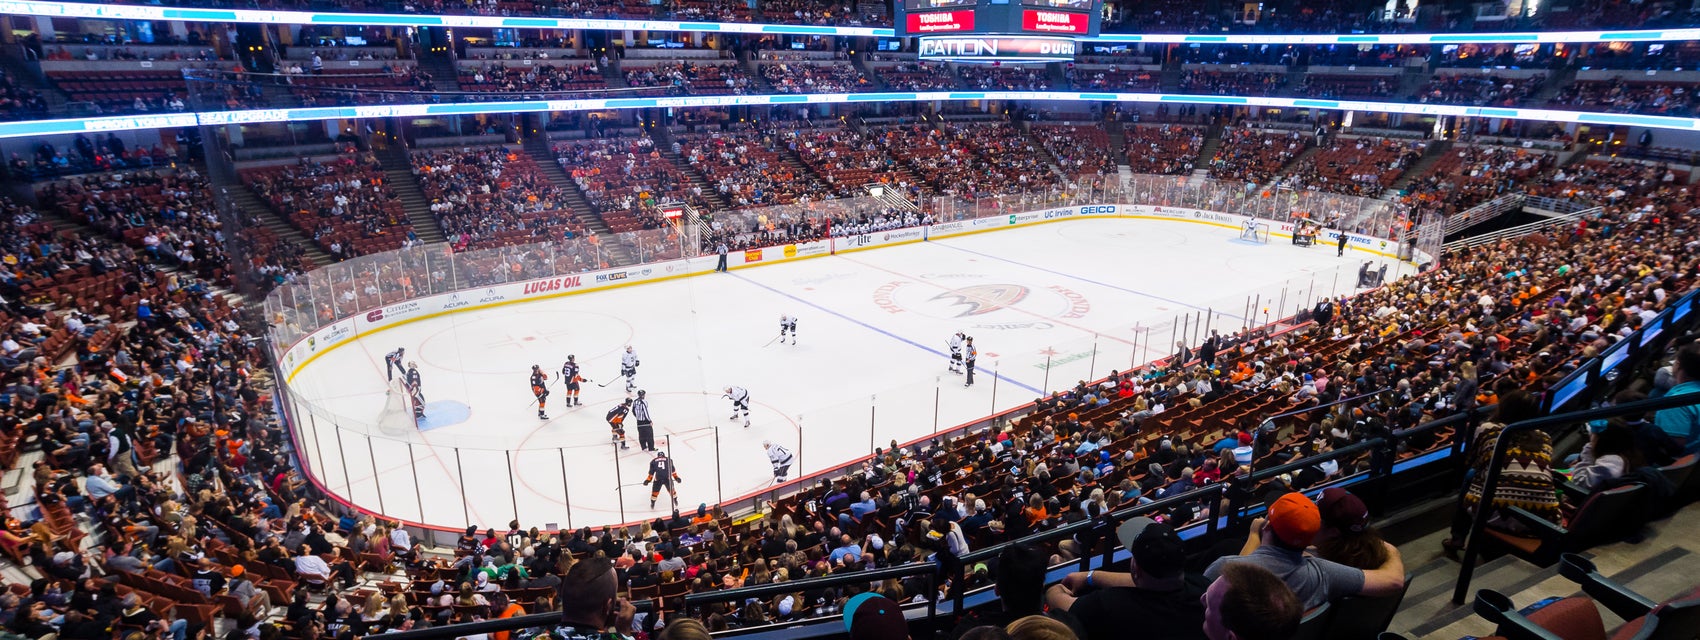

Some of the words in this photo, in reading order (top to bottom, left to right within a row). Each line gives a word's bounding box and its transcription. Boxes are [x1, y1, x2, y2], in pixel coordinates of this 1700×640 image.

[919, 13, 953, 23] TOSHIBA
[1037, 12, 1070, 23] TOSHIBA
[136, 117, 170, 128] YOUR
[199, 113, 228, 125] SEAT
[232, 109, 288, 122] UPGRADE
[1055, 209, 1073, 217] Irvine
[1081, 206, 1115, 214] GEICO
[857, 234, 871, 246] Lite
[1351, 236, 1371, 245] TIRES
[609, 272, 627, 280] LIVE
[524, 279, 561, 294] LUCAS
[563, 276, 581, 288] OIL
[873, 281, 905, 314] HONDA
[1047, 285, 1090, 318] HONDA
[443, 301, 469, 309] ACURA
[658, 461, 665, 469] 4
